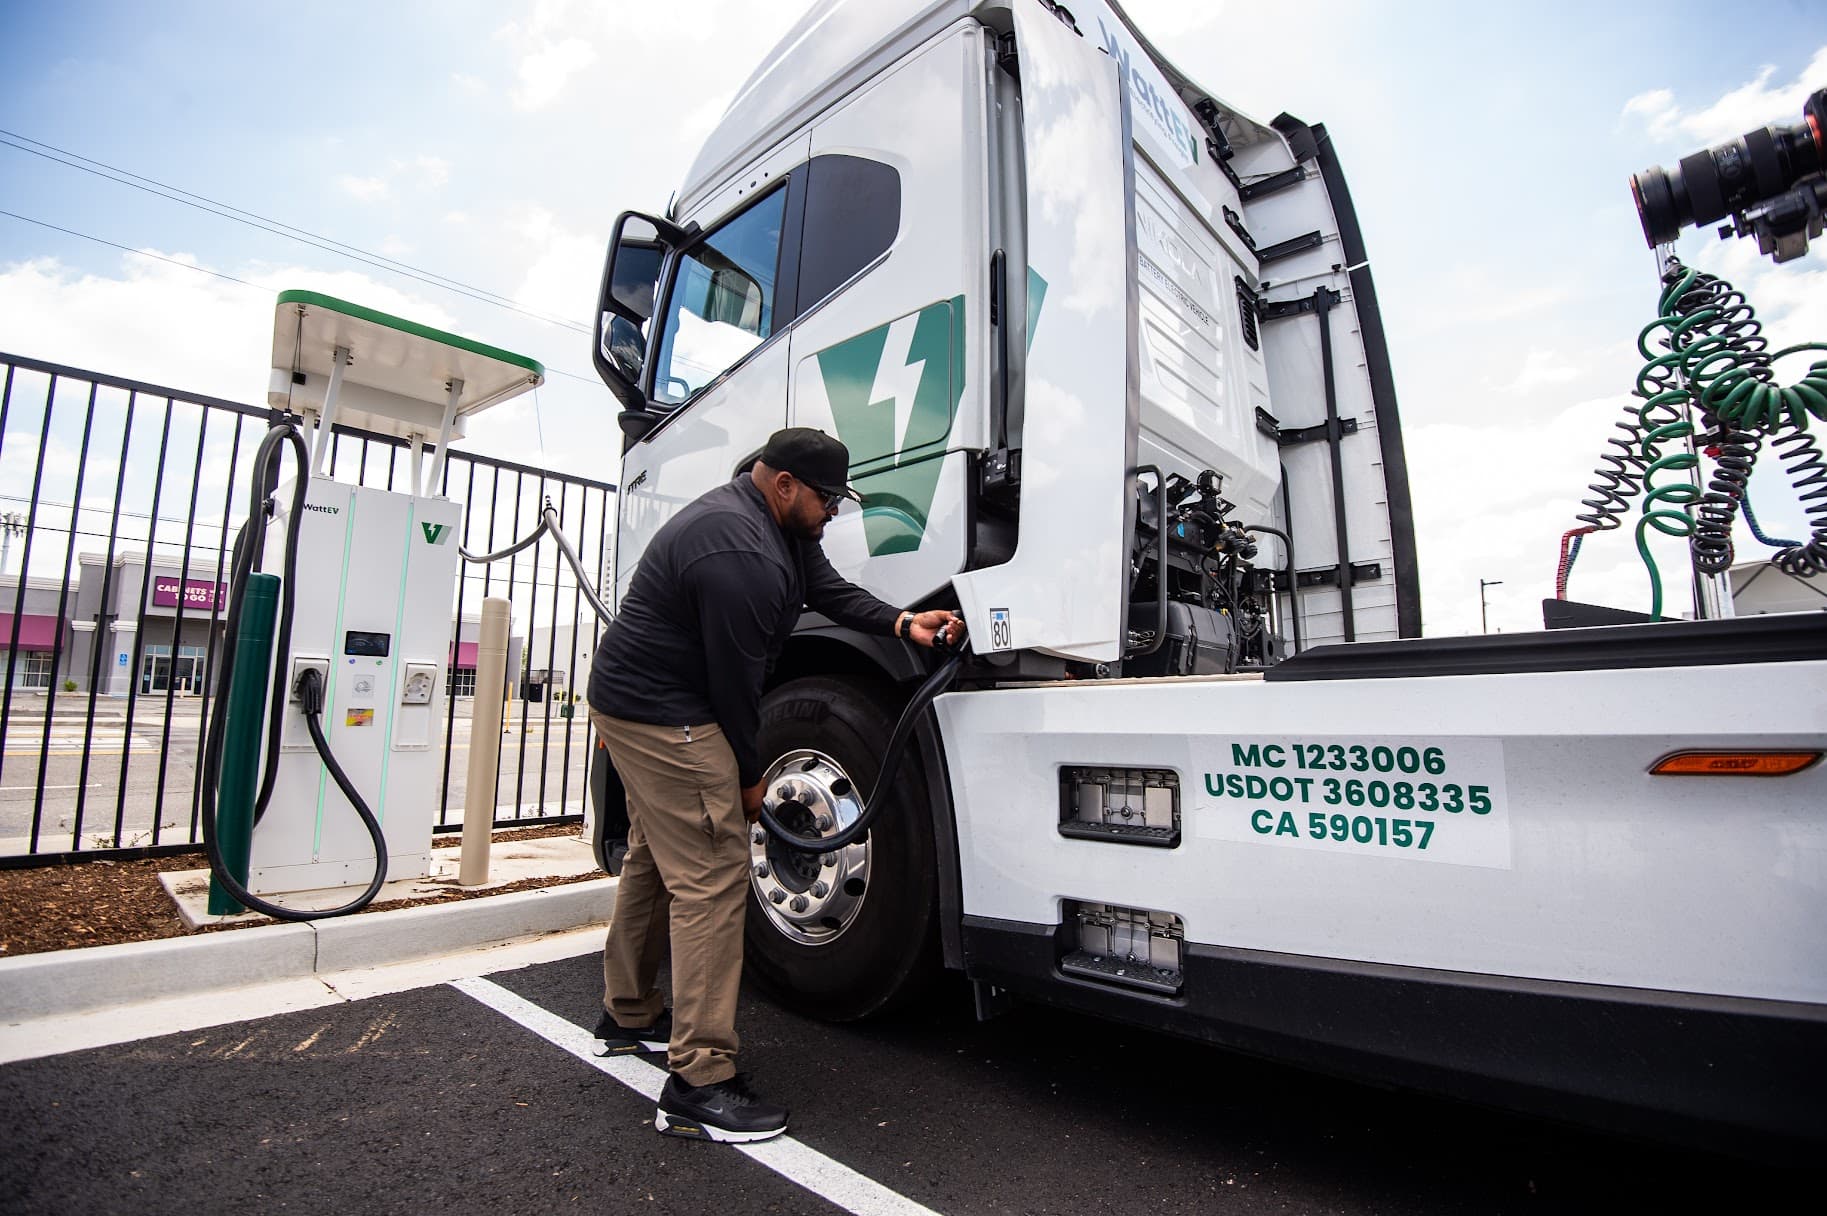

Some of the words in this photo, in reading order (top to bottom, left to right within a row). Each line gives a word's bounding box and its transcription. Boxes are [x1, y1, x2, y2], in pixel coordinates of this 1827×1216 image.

[1097, 16, 1199, 166] WattEV
[303, 503, 340, 515] WattEV
[157, 584, 208, 595] CABNETS
[189, 594, 206, 602] GO
[993, 620, 1009, 647] 80
[1231, 743, 1286, 768] MC
[1292, 744, 1446, 775] 1233006
[1204, 773, 1314, 803] USDOT
[1323, 778, 1492, 815] 3608335
[1251, 809, 1299, 838] CA
[1309, 812, 1435, 850] 590157
